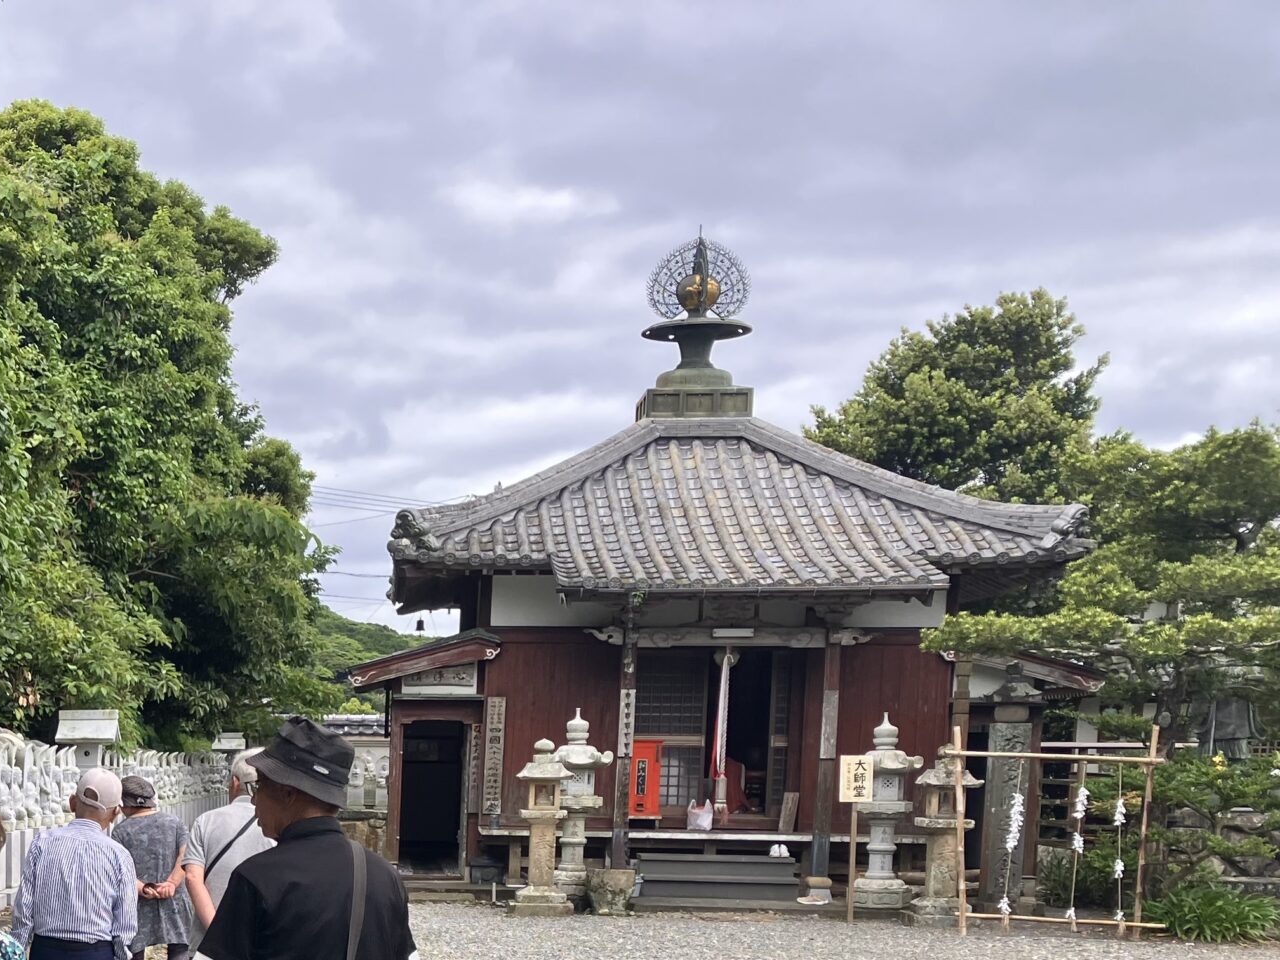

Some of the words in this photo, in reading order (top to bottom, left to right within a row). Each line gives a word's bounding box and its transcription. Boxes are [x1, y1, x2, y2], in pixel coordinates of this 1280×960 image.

[636, 761, 646, 795] おみくじ
[853, 759, 868, 798] 大師堂
